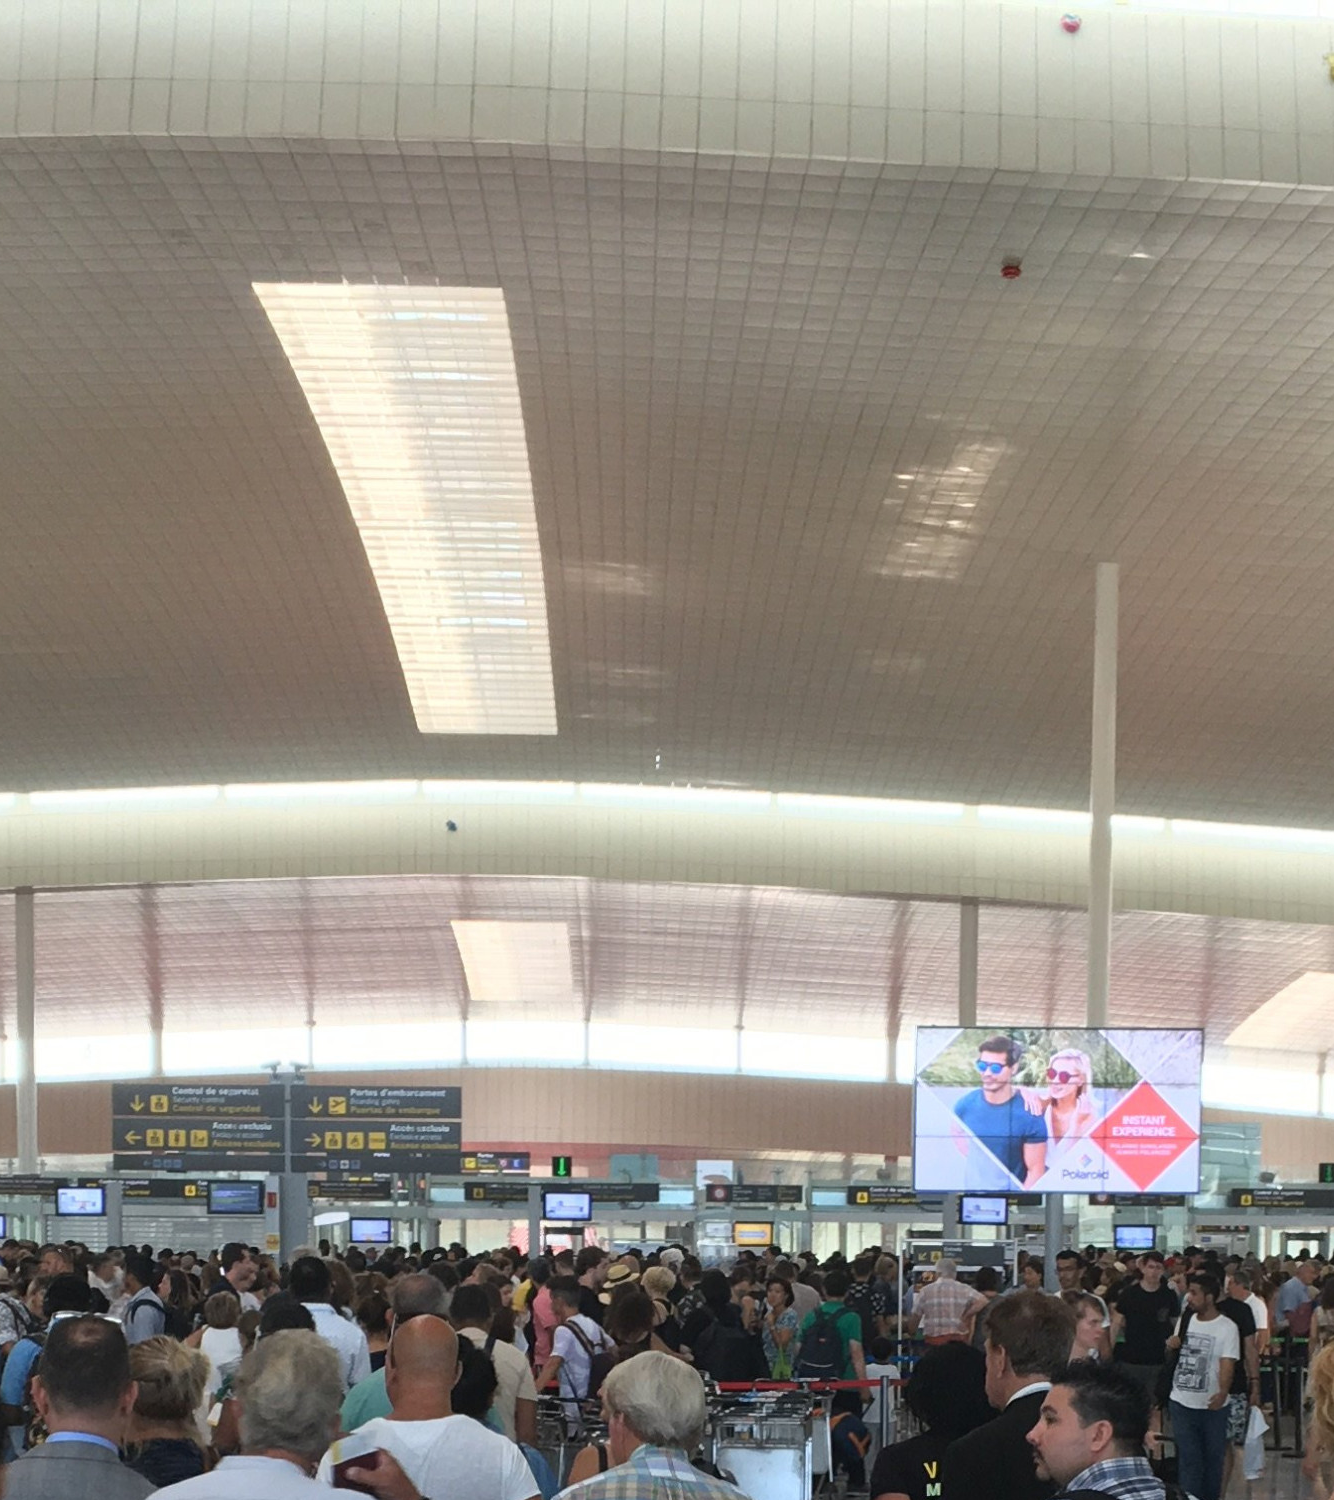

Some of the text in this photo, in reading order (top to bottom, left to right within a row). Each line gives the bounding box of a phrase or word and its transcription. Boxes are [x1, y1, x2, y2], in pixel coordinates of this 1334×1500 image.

[172, 1087, 203, 1095] Control
[205, 1087, 217, 1095] de
[350, 1088, 446, 1097] Portes d'embarcament
[219, 1105, 261, 1114] seguridad
[385, 1106, 396, 1114] de
[1122, 1115, 1165, 1125] INSTANT
[1112, 1127, 1176, 1136] EXPERIENCE
[1062, 1168, 1109, 1179] Polaroid
